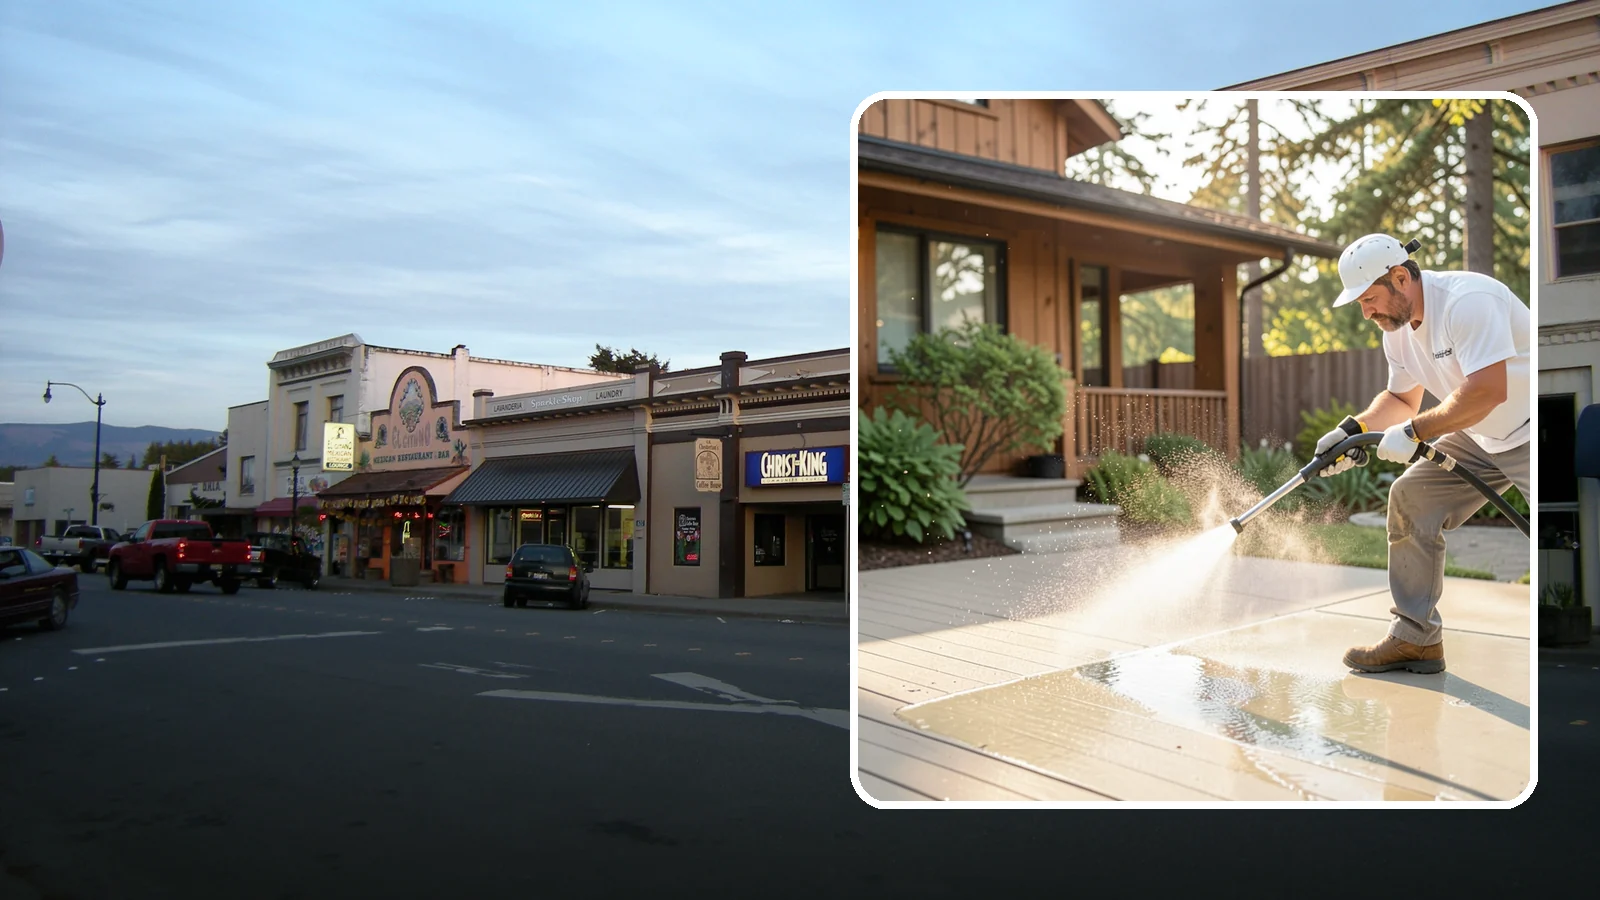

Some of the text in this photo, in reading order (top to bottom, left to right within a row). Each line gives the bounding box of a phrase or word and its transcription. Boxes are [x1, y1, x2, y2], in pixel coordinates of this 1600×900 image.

[595, 389, 624, 400] LAUNDRY
[493, 402, 523, 413] LAVANDERIA
[531, 394, 582, 409] Sparkle Shop
[373, 450, 450, 464] MEXICAN RESTAURANT BAR
